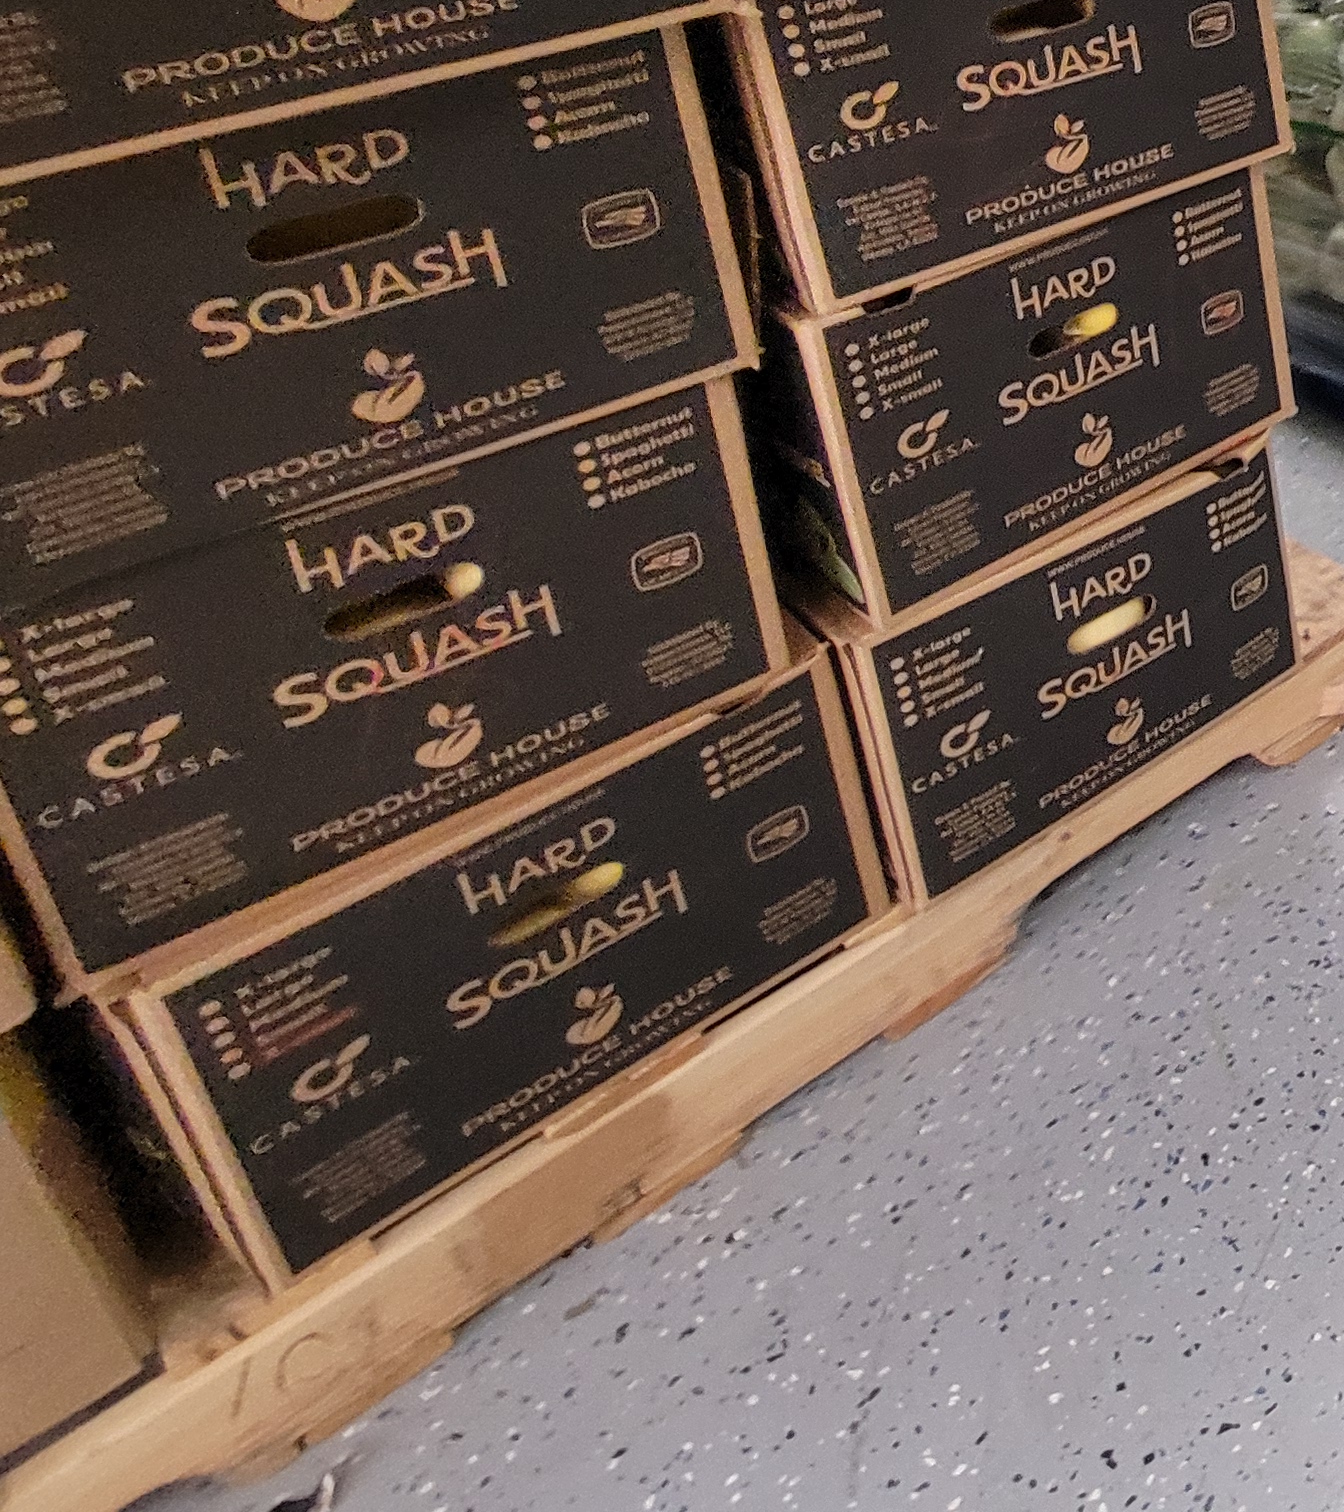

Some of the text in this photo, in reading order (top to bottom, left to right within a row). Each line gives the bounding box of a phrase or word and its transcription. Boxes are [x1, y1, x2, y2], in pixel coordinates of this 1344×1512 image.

[120, 25, 362, 94] PRODUCE
[956, 24, 1143, 113] SQUASH
[200, 128, 410, 211] HARD
[807, 116, 930, 164] CASTESA
[965, 172, 1089, 226] PRODUCE
[1093, 142, 1176, 182] HOUSE
[190, 228, 509, 359] SQUASH
[1010, 255, 1117, 321] HARD
[0, 370, 147, 426] STESA
[998, 324, 1161, 426] SQUASH
[215, 419, 421, 500] PRODUCE
[436, 370, 568, 430] HOUSE
[869, 436, 976, 496] CASTESA
[1004, 464, 1113, 530] PRODUCE
[1115, 424, 1187, 469] HOUSE
[285, 504, 476, 593] HARD
[1048, 551, 1152, 621] HARD
[272, 584, 561, 729] SQUASH
[1037, 608, 1192, 721] SQUASH
[36, 746, 231, 830] CASTESA
[291, 754, 479, 854] PRODUCE
[491, 702, 613, 771] HOUSE
[911, 733, 1014, 793] CASTESA
[1039, 728, 1146, 809] PRODUCE
[1144, 694, 1213, 748] HOUSE
[455, 817, 618, 915] HARD
[443, 869, 690, 1030] SQUASH
[460, 967, 734, 1138] PRODUCE HOUSE
